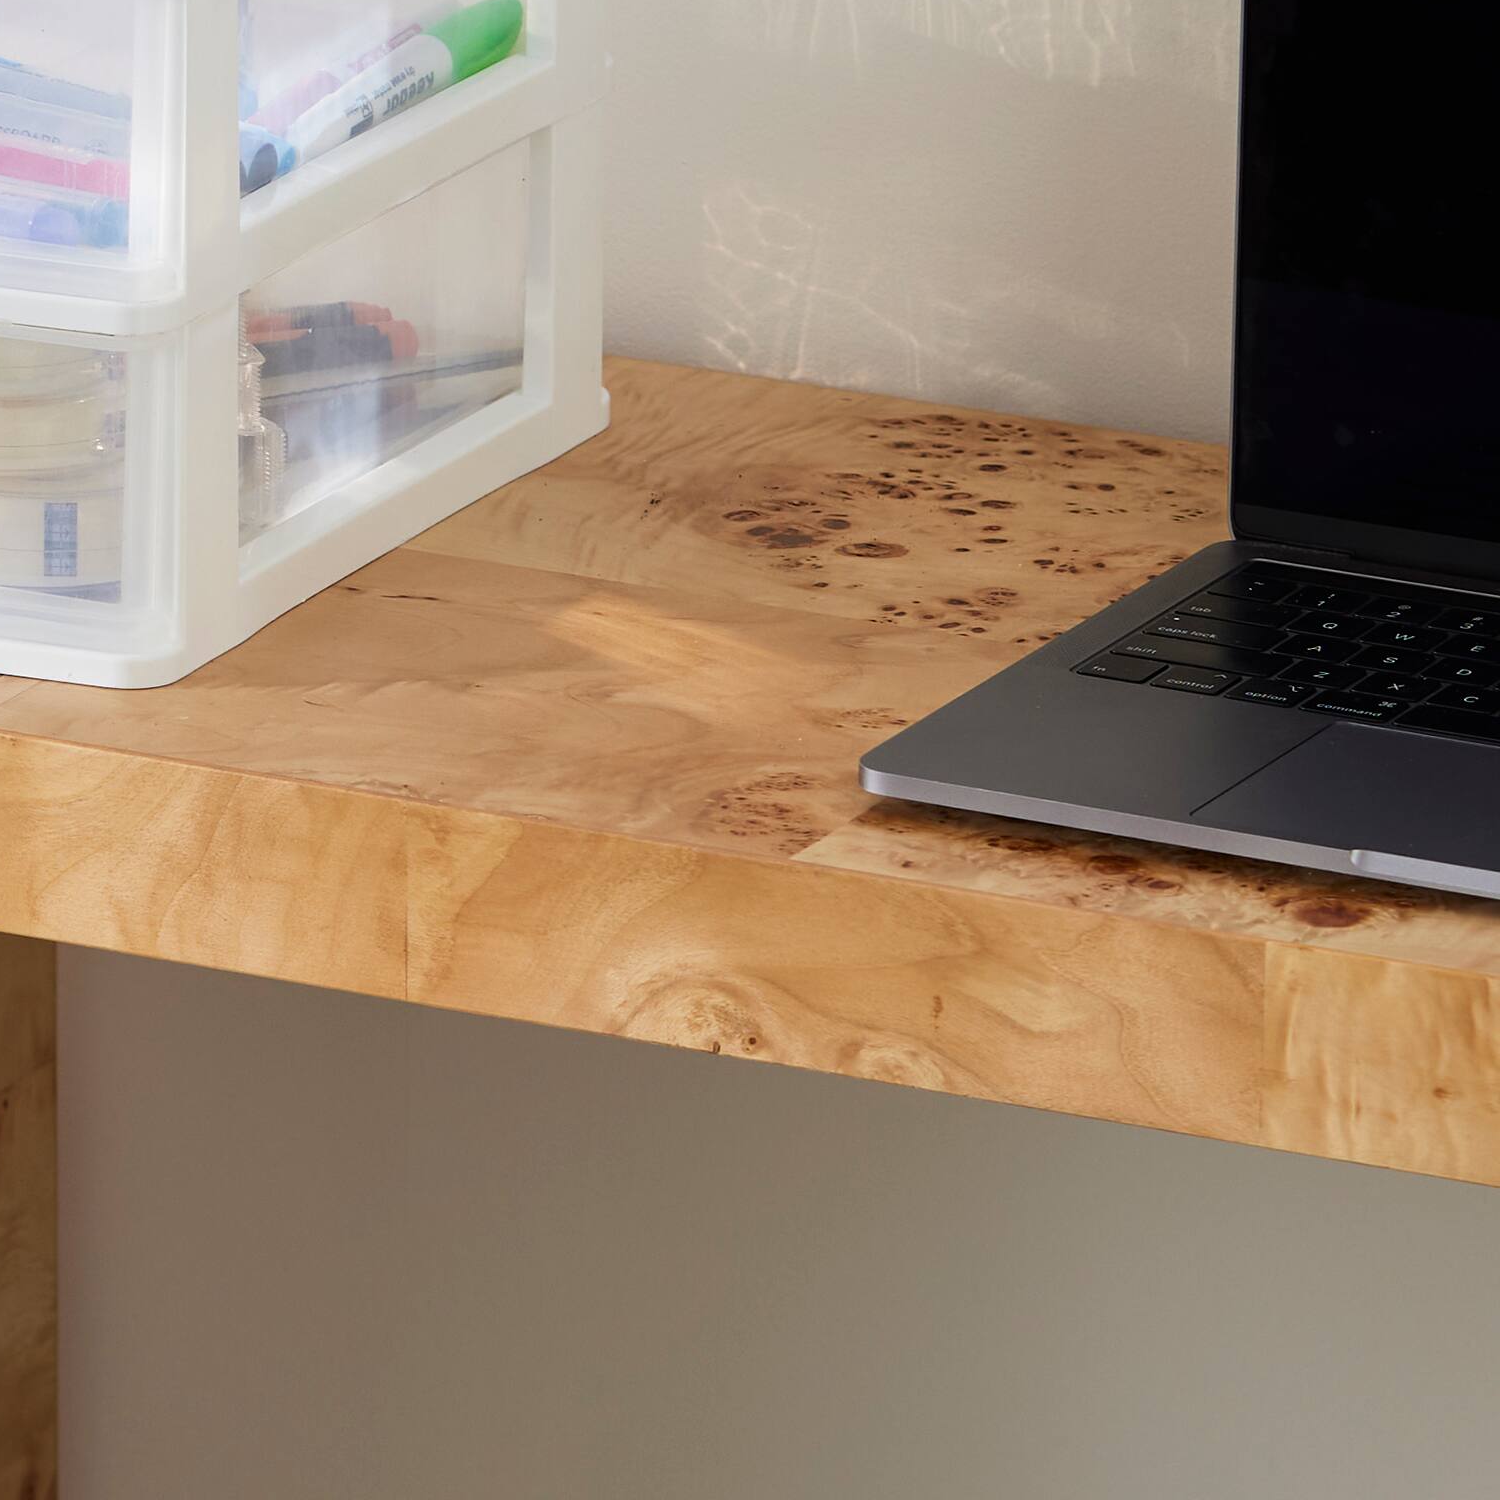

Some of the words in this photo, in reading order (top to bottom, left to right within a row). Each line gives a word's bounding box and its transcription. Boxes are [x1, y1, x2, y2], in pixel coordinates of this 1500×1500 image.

[1190, 605, 1212, 613] tab
[1322, 622, 1338, 630] Q
[1157, 626, 1188, 635] caps
[1190, 630, 1217, 639] lock
[1395, 633, 1416, 641] W
[1125, 644, 1158, 655] shift
[1470, 645, 1486, 653] E
[1382, 656, 1399, 664] S
[1312, 671, 1330, 679] Z
[1456, 668, 1473, 676] D
[1166, 678, 1215, 690] control
[1387, 683, 1405, 691] X
[1244, 691, 1288, 701] option
[1463, 695, 1480, 703] C
[1316, 703, 1383, 717] command
